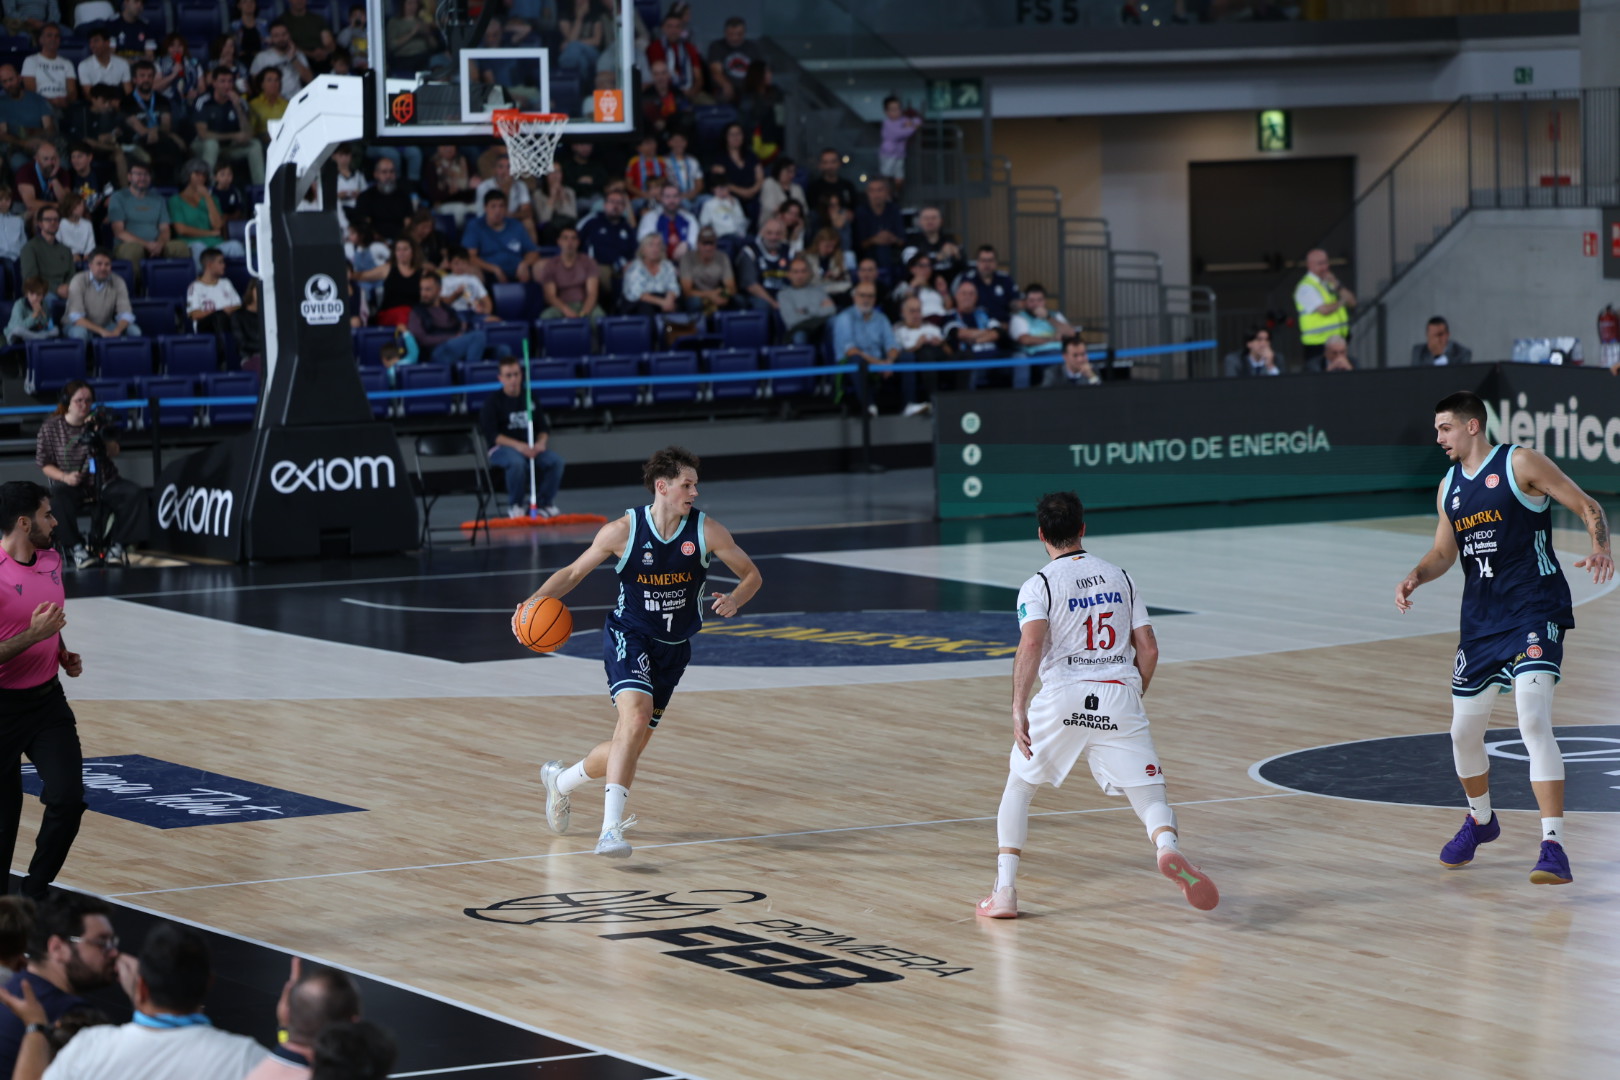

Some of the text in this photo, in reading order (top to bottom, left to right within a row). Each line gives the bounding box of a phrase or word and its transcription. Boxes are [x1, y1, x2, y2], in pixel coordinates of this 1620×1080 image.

[303, 303, 341, 314] OVIEDO
[1070, 425, 1330, 466] TU PUNTO DE ENERGÍA
[271, 455, 395, 494] exiom
[158, 483, 233, 537] exiom
[637, 571, 692, 586] ALIMERKA
[1076, 574, 1106, 589] COSTA
[652, 589, 684, 600] OVIEDO
[1068, 592, 1123, 612] PULEVA
[662, 613, 674, 632] 7
[1083, 611, 1116, 650] 15
[1063, 718, 1119, 731] GRANADA
[1072, 712, 1110, 723] SABOR
[600, 925, 905, 990] FEB
[735, 919, 974, 977] PRIMERA
